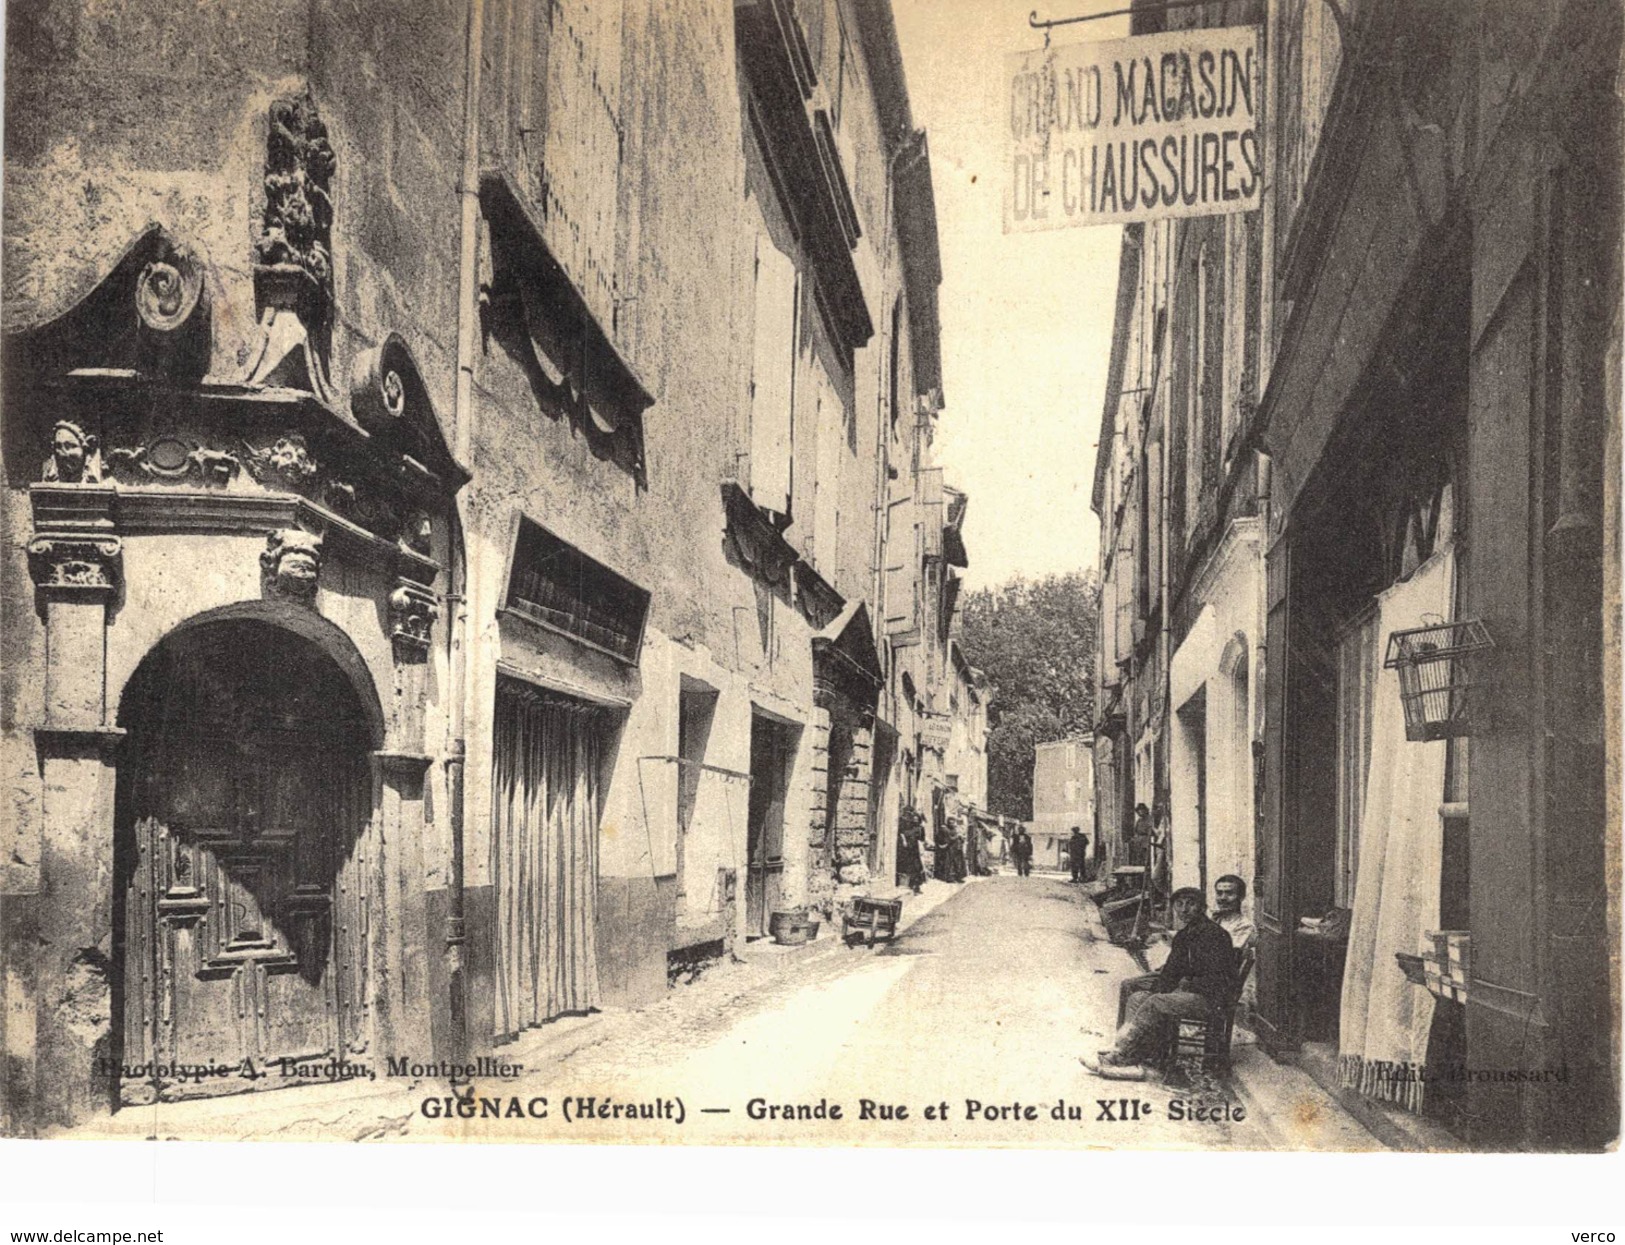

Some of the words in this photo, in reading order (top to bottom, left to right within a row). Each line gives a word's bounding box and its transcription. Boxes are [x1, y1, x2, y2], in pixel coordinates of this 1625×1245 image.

[1010, 64, 1101, 143] GRAND
[1112, 47, 1254, 127] MAGASIN
[1013, 152, 1050, 221] DE
[1062, 128, 1261, 216] CHAUSSURES
